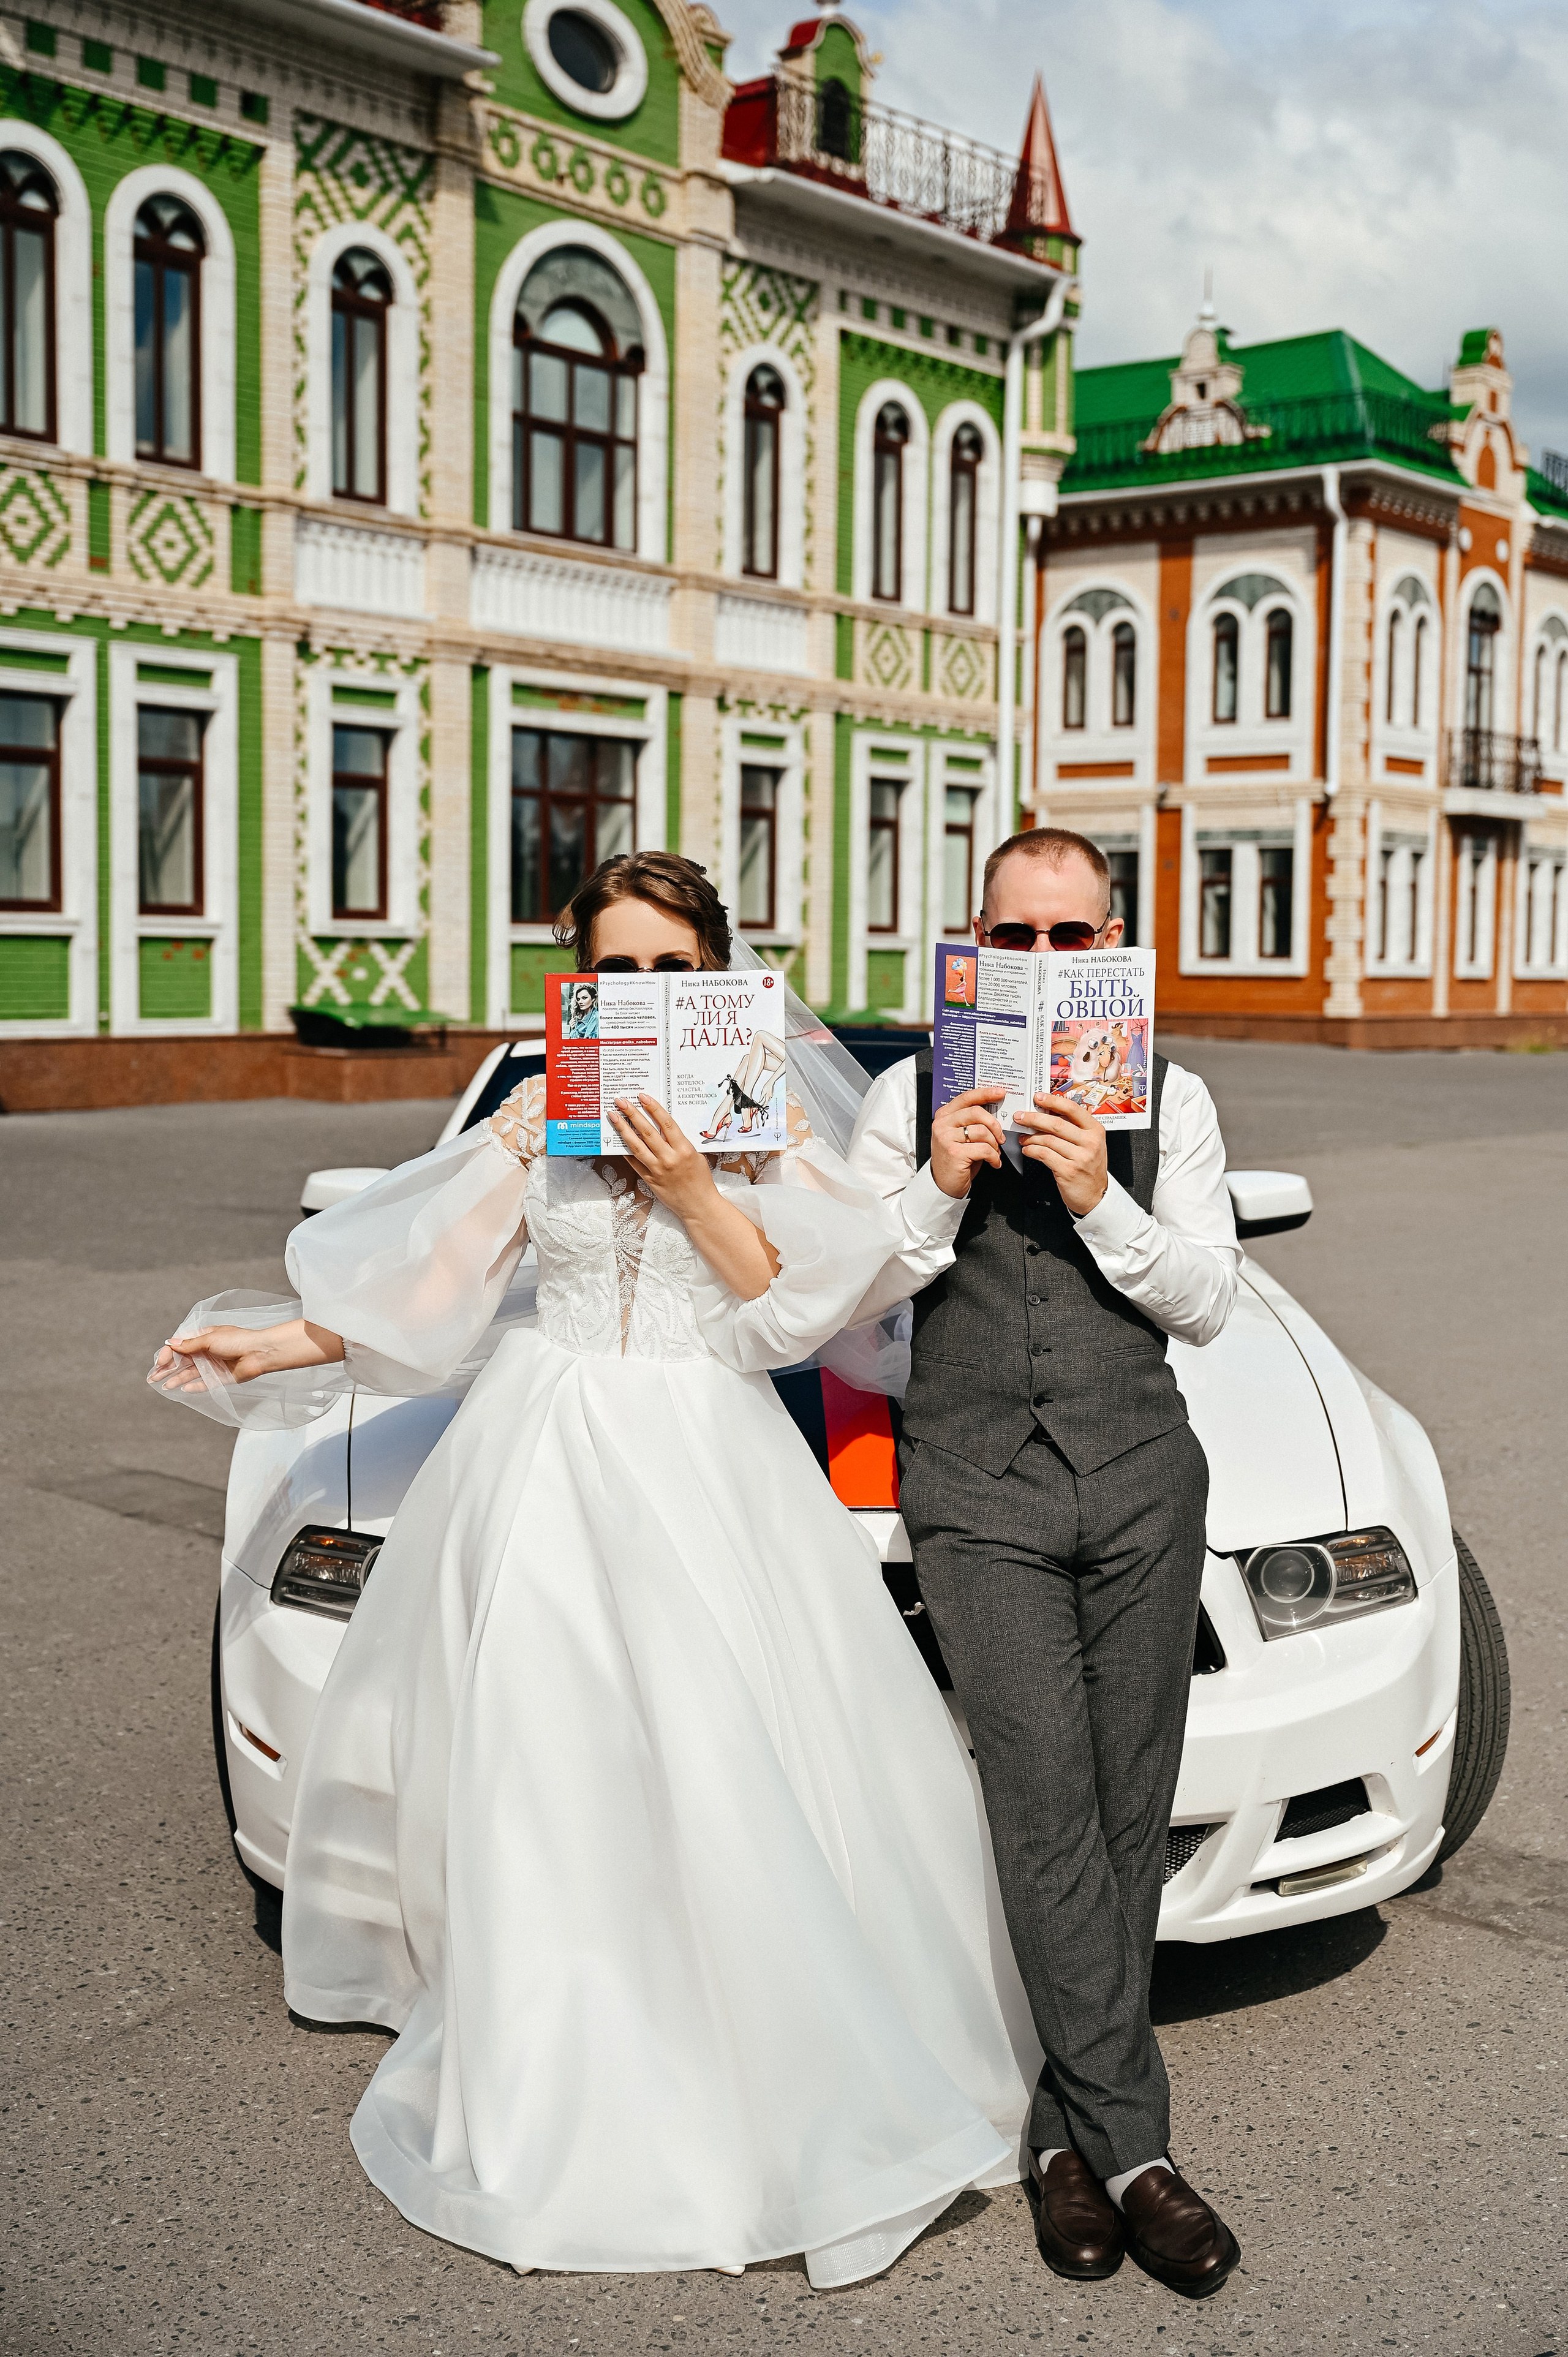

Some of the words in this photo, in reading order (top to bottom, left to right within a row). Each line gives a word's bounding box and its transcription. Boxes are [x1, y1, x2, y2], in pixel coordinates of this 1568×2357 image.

[1058, 968, 1084, 978] #КАК
[1087, 967, 1145, 978] ПЕРЕСТАТЬ
[1069, 979, 1133, 998] БЫТЬ
[675, 995, 697, 1010] #А
[699, 994, 756, 1009] ТОМУ
[1057, 994, 1144, 1020] ОВЦОЙ
[693, 1011, 722, 1025] ЛИ
[725, 1011, 737, 1025] Я
[679, 1027, 752, 1051] ДАЛА?
[666, 1074, 671, 1087] ЛИ
